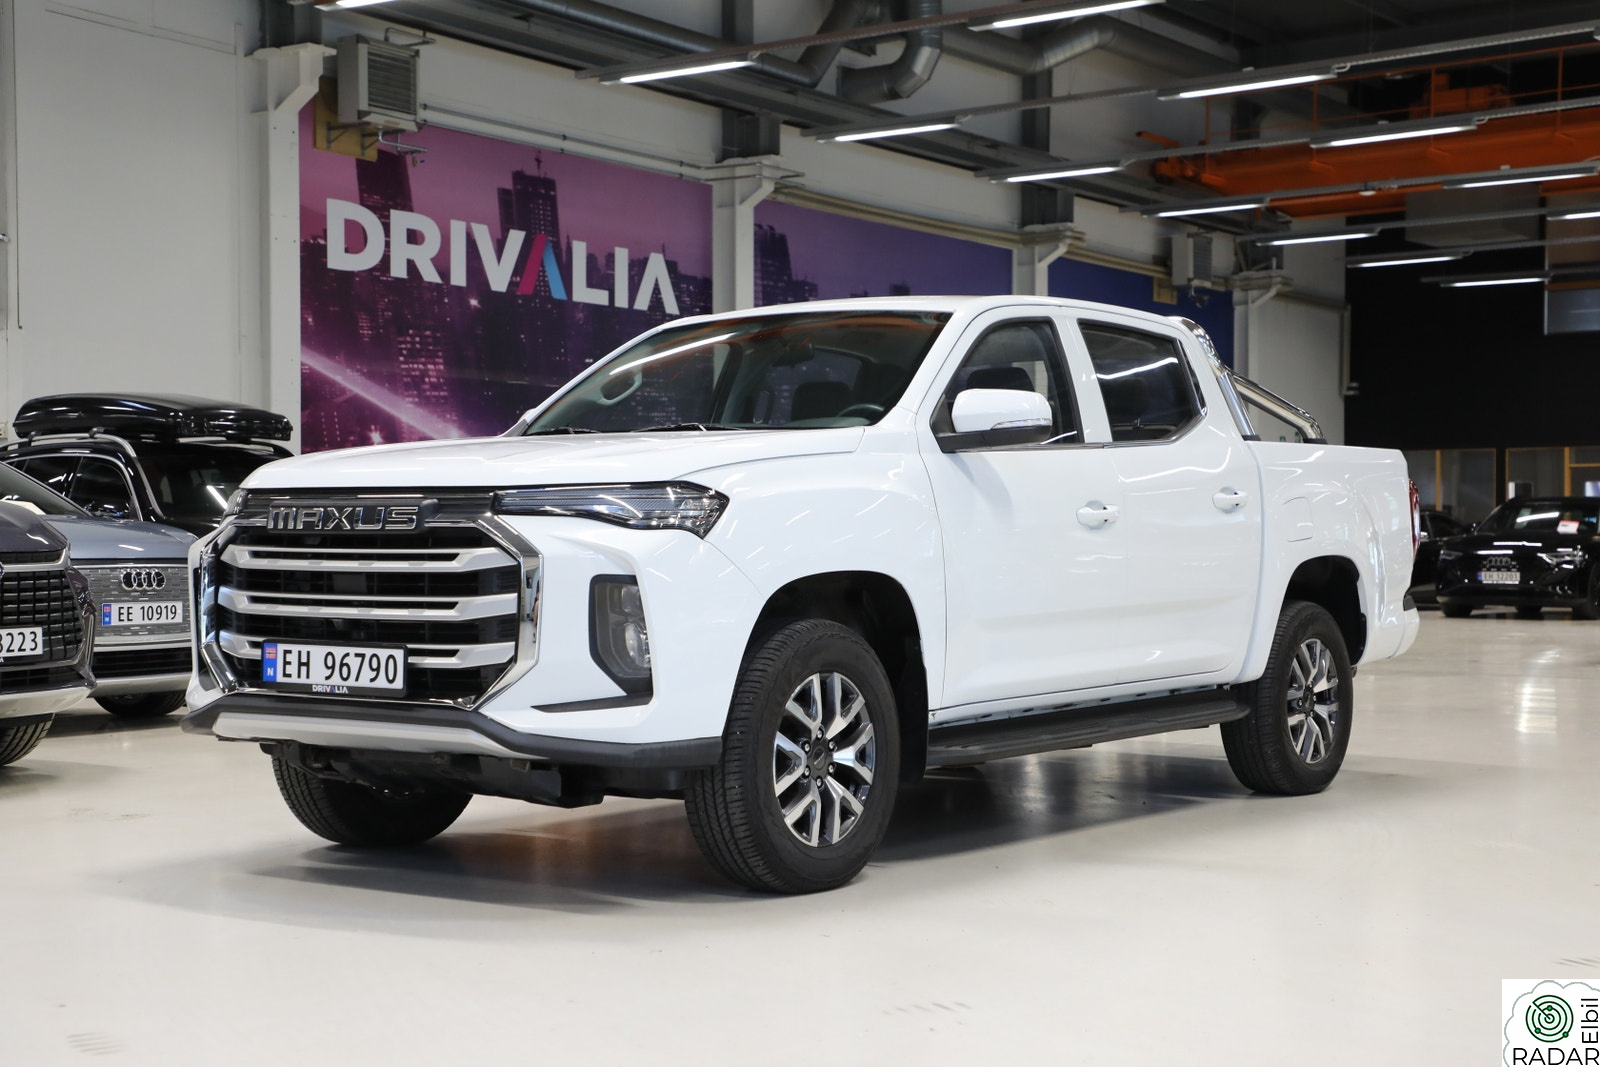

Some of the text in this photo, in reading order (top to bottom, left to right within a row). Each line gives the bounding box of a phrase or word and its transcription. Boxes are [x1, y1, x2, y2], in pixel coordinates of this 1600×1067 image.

[326, 198, 680, 315] DRIVALIA
[267, 507, 419, 530] MAXUS
[118, 606, 133, 622] EE
[140, 604, 177, 621] 10919
[267, 649, 398, 684] N EH 96790
[312, 684, 349, 694] DRIVALIA
